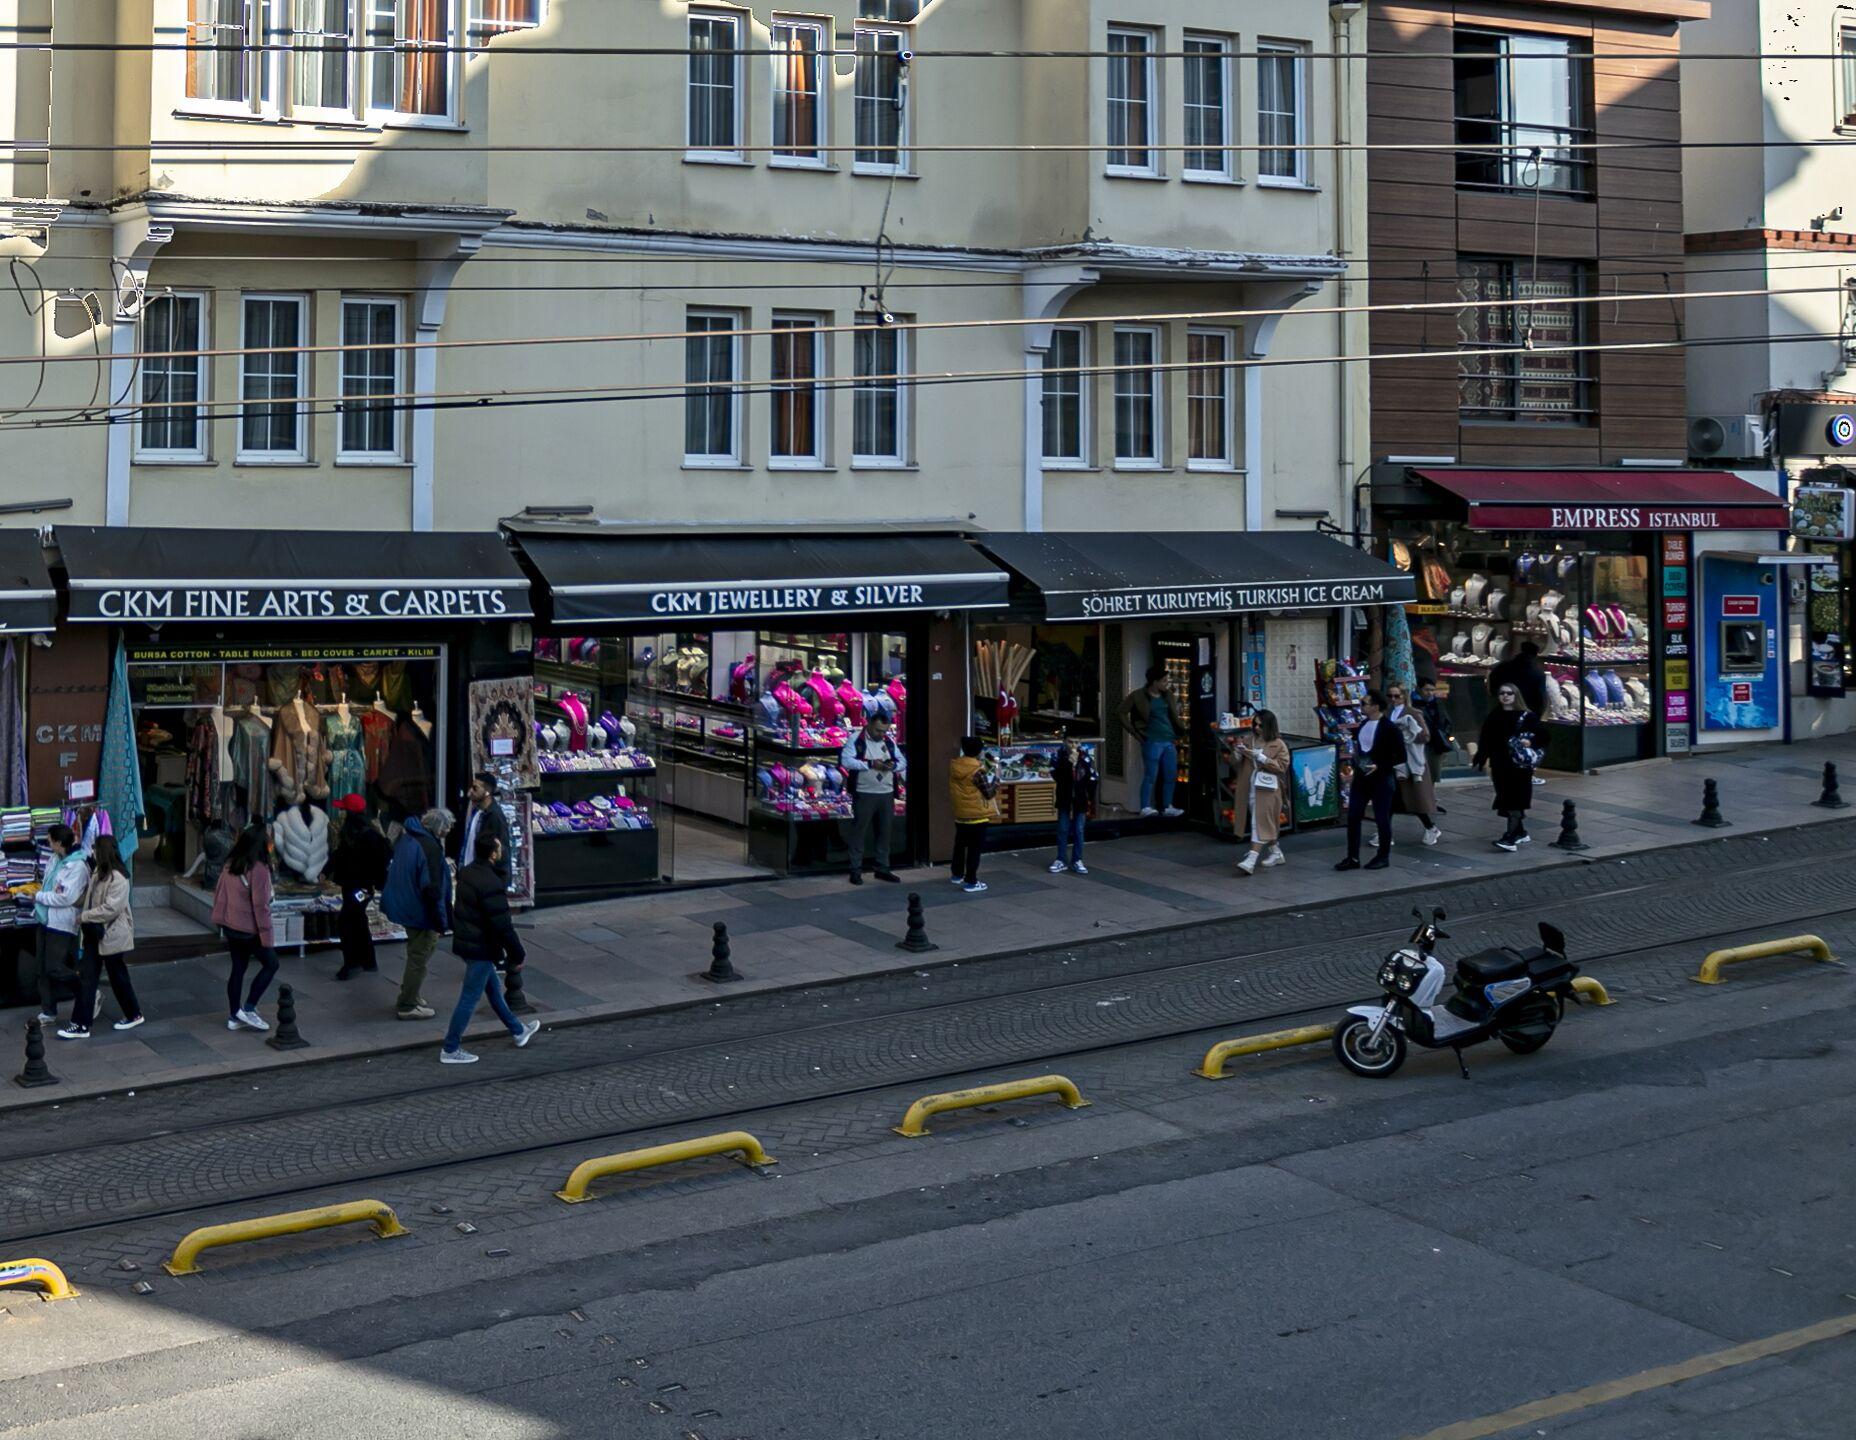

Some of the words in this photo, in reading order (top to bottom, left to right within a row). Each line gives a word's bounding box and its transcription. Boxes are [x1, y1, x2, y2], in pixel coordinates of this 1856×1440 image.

[1551, 508, 1641, 528] EMPRESS
[1649, 512, 1720, 528] ISTANBUL
[98, 591, 174, 617] CKM
[184, 591, 250, 617] FINE
[258, 590, 335, 617] ARTS
[345, 594, 372, 616] &
[379, 589, 507, 616] CARPETS
[651, 591, 702, 614] CKM
[709, 588, 822, 615] JEWELLERY
[831, 589, 849, 606] &
[855, 584, 924, 606] SILVER
[1082, 593, 1142, 618] ŞÖHRET
[1147, 587, 1233, 611] KURUYEMİŞ
[1237, 588, 1299, 606] TURKISH
[1304, 587, 1327, 603] ICE
[1331, 584, 1384, 603] CREAM
[133, 650, 167, 659] BURSA
[170, 650, 210, 659] COTTON
[218, 650, 250, 658] TABLE
[252, 649, 292, 658] RUNNER
[301, 649, 320, 657] BED
[323, 649, 354, 657] COVER
[363, 648, 400, 657] CARPET
[407, 648, 434, 656] KILIM
[35, 724, 103, 744] CKM
